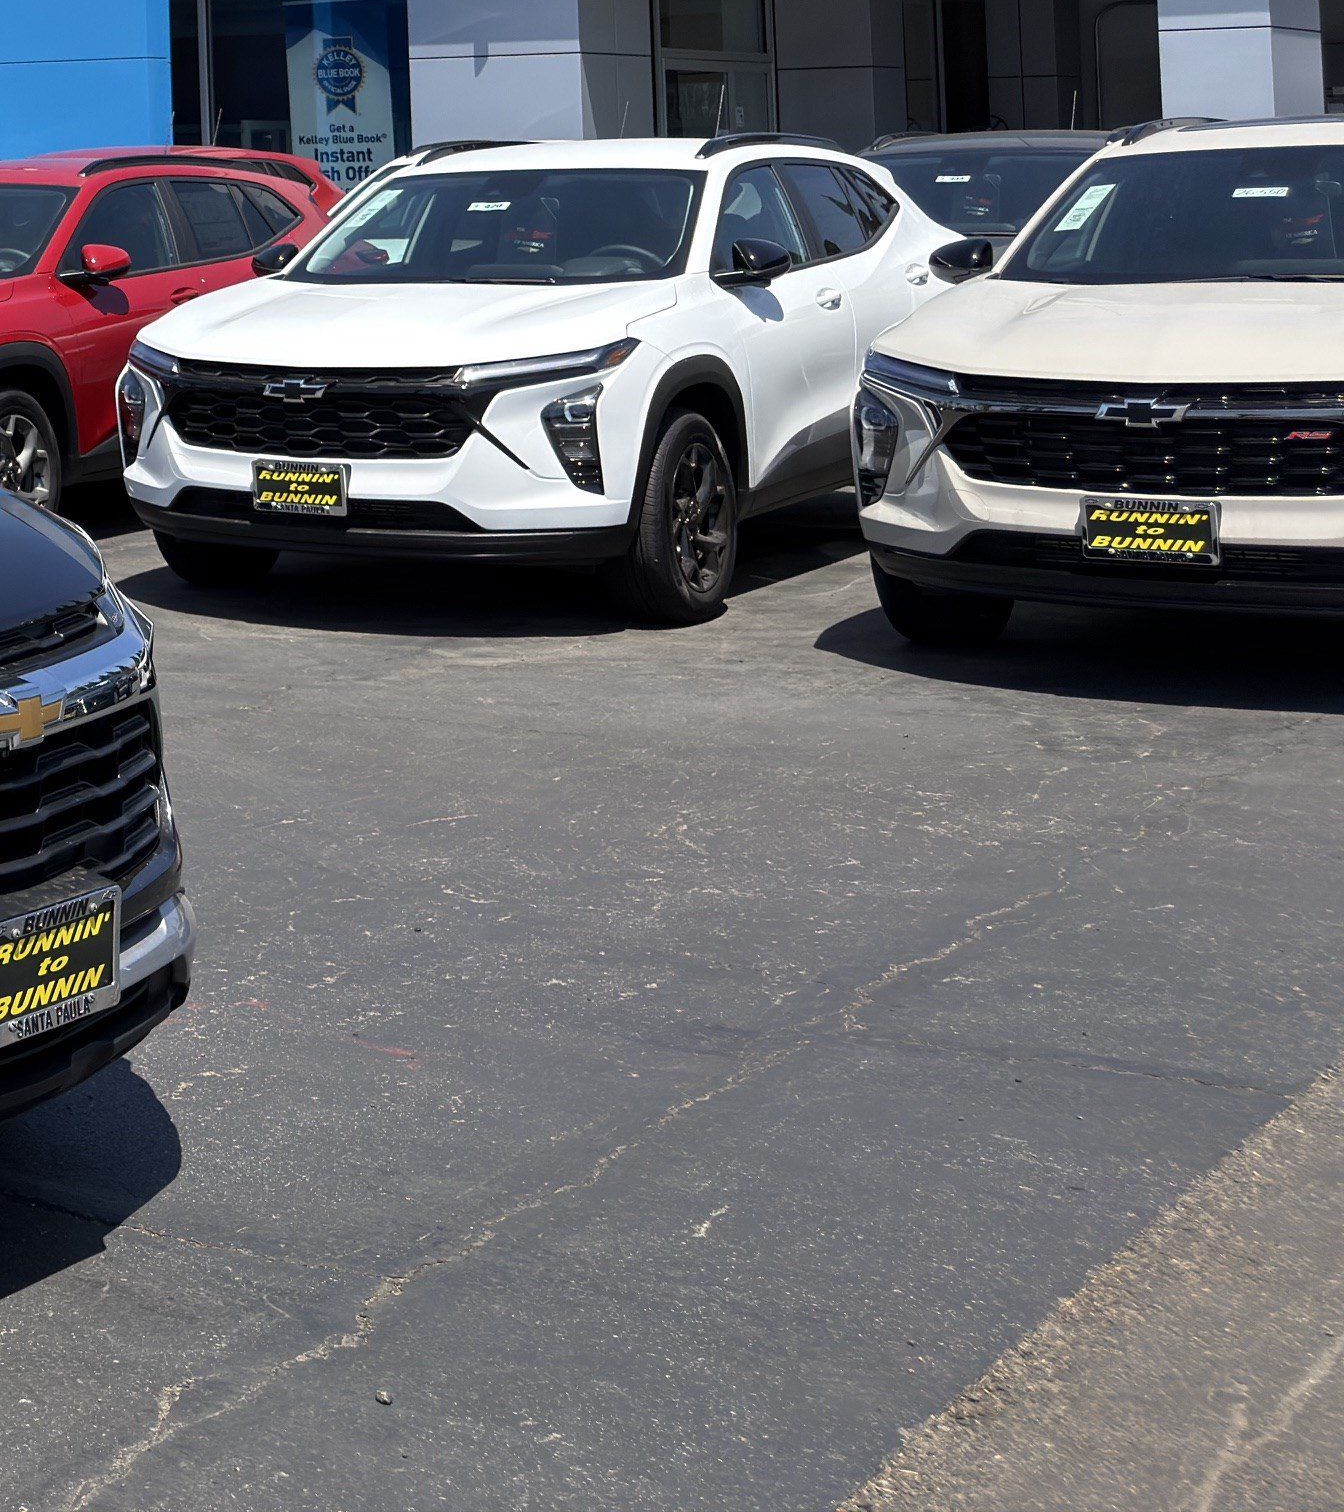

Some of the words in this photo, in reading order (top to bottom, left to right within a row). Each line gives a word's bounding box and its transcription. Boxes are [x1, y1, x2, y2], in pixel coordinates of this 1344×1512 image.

[322, 51, 358, 67] KELLEY
[317, 69, 337, 79] BLUE
[338, 68, 361, 78] BOOK
[329, 124, 346, 133] Get
[298, 135, 329, 146] Kelley
[332, 134, 355, 144] Blue
[314, 148, 373, 163] Instant
[274, 462, 319, 472] BUNNIN
[259, 470, 340, 483] RUNNIN'
[289, 482, 310, 491] to
[259, 491, 338, 505] BUNNIN
[1113, 499, 1180, 512] BUNNIN
[1089, 509, 1209, 525] RUNNIN'
[1135, 525, 1165, 535] to
[1090, 535, 1205, 552] BUNNIN
[23, 898, 90, 934] BUNNIN
[37, 955, 69, 977] to
[15, 1011, 53, 1039] SANTA
[56, 995, 92, 1026] PAULA
